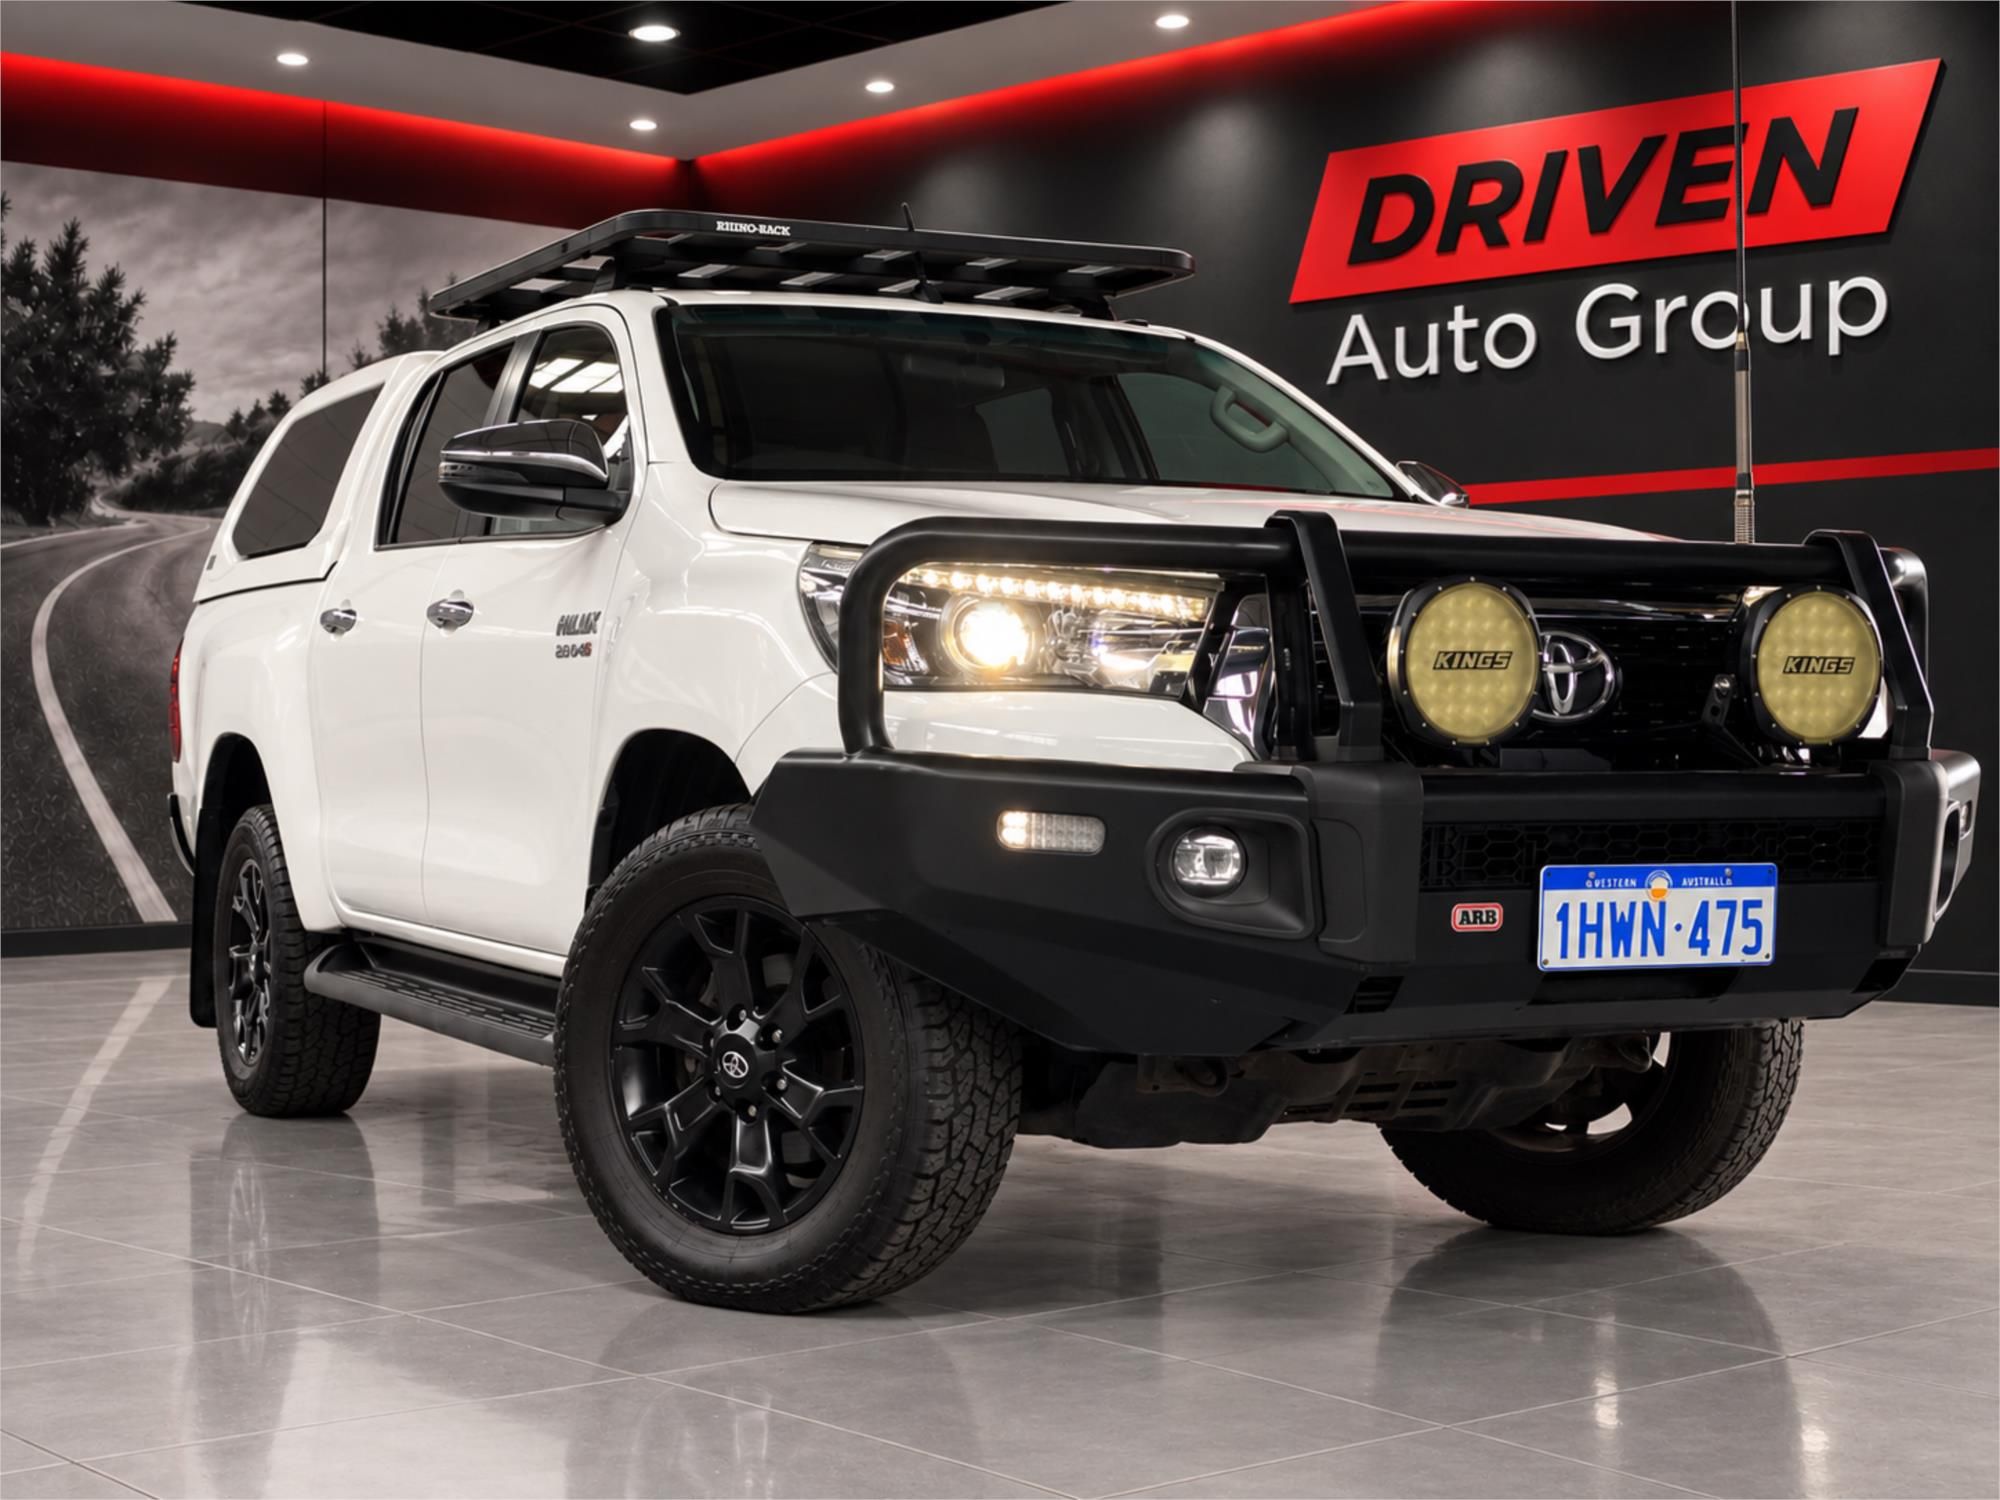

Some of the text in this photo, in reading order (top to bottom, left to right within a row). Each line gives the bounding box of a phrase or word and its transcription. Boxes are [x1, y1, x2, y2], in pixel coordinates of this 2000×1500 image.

[1347, 107, 1859, 265] DRIVEN
[716, 221, 791, 236] RHINO-RACK
[1326, 276, 1888, 386] Auto Group
[1434, 651, 1512, 670] KINGS
[1784, 656, 1854, 674] KINGS
[1458, 909, 1498, 926] ARB
